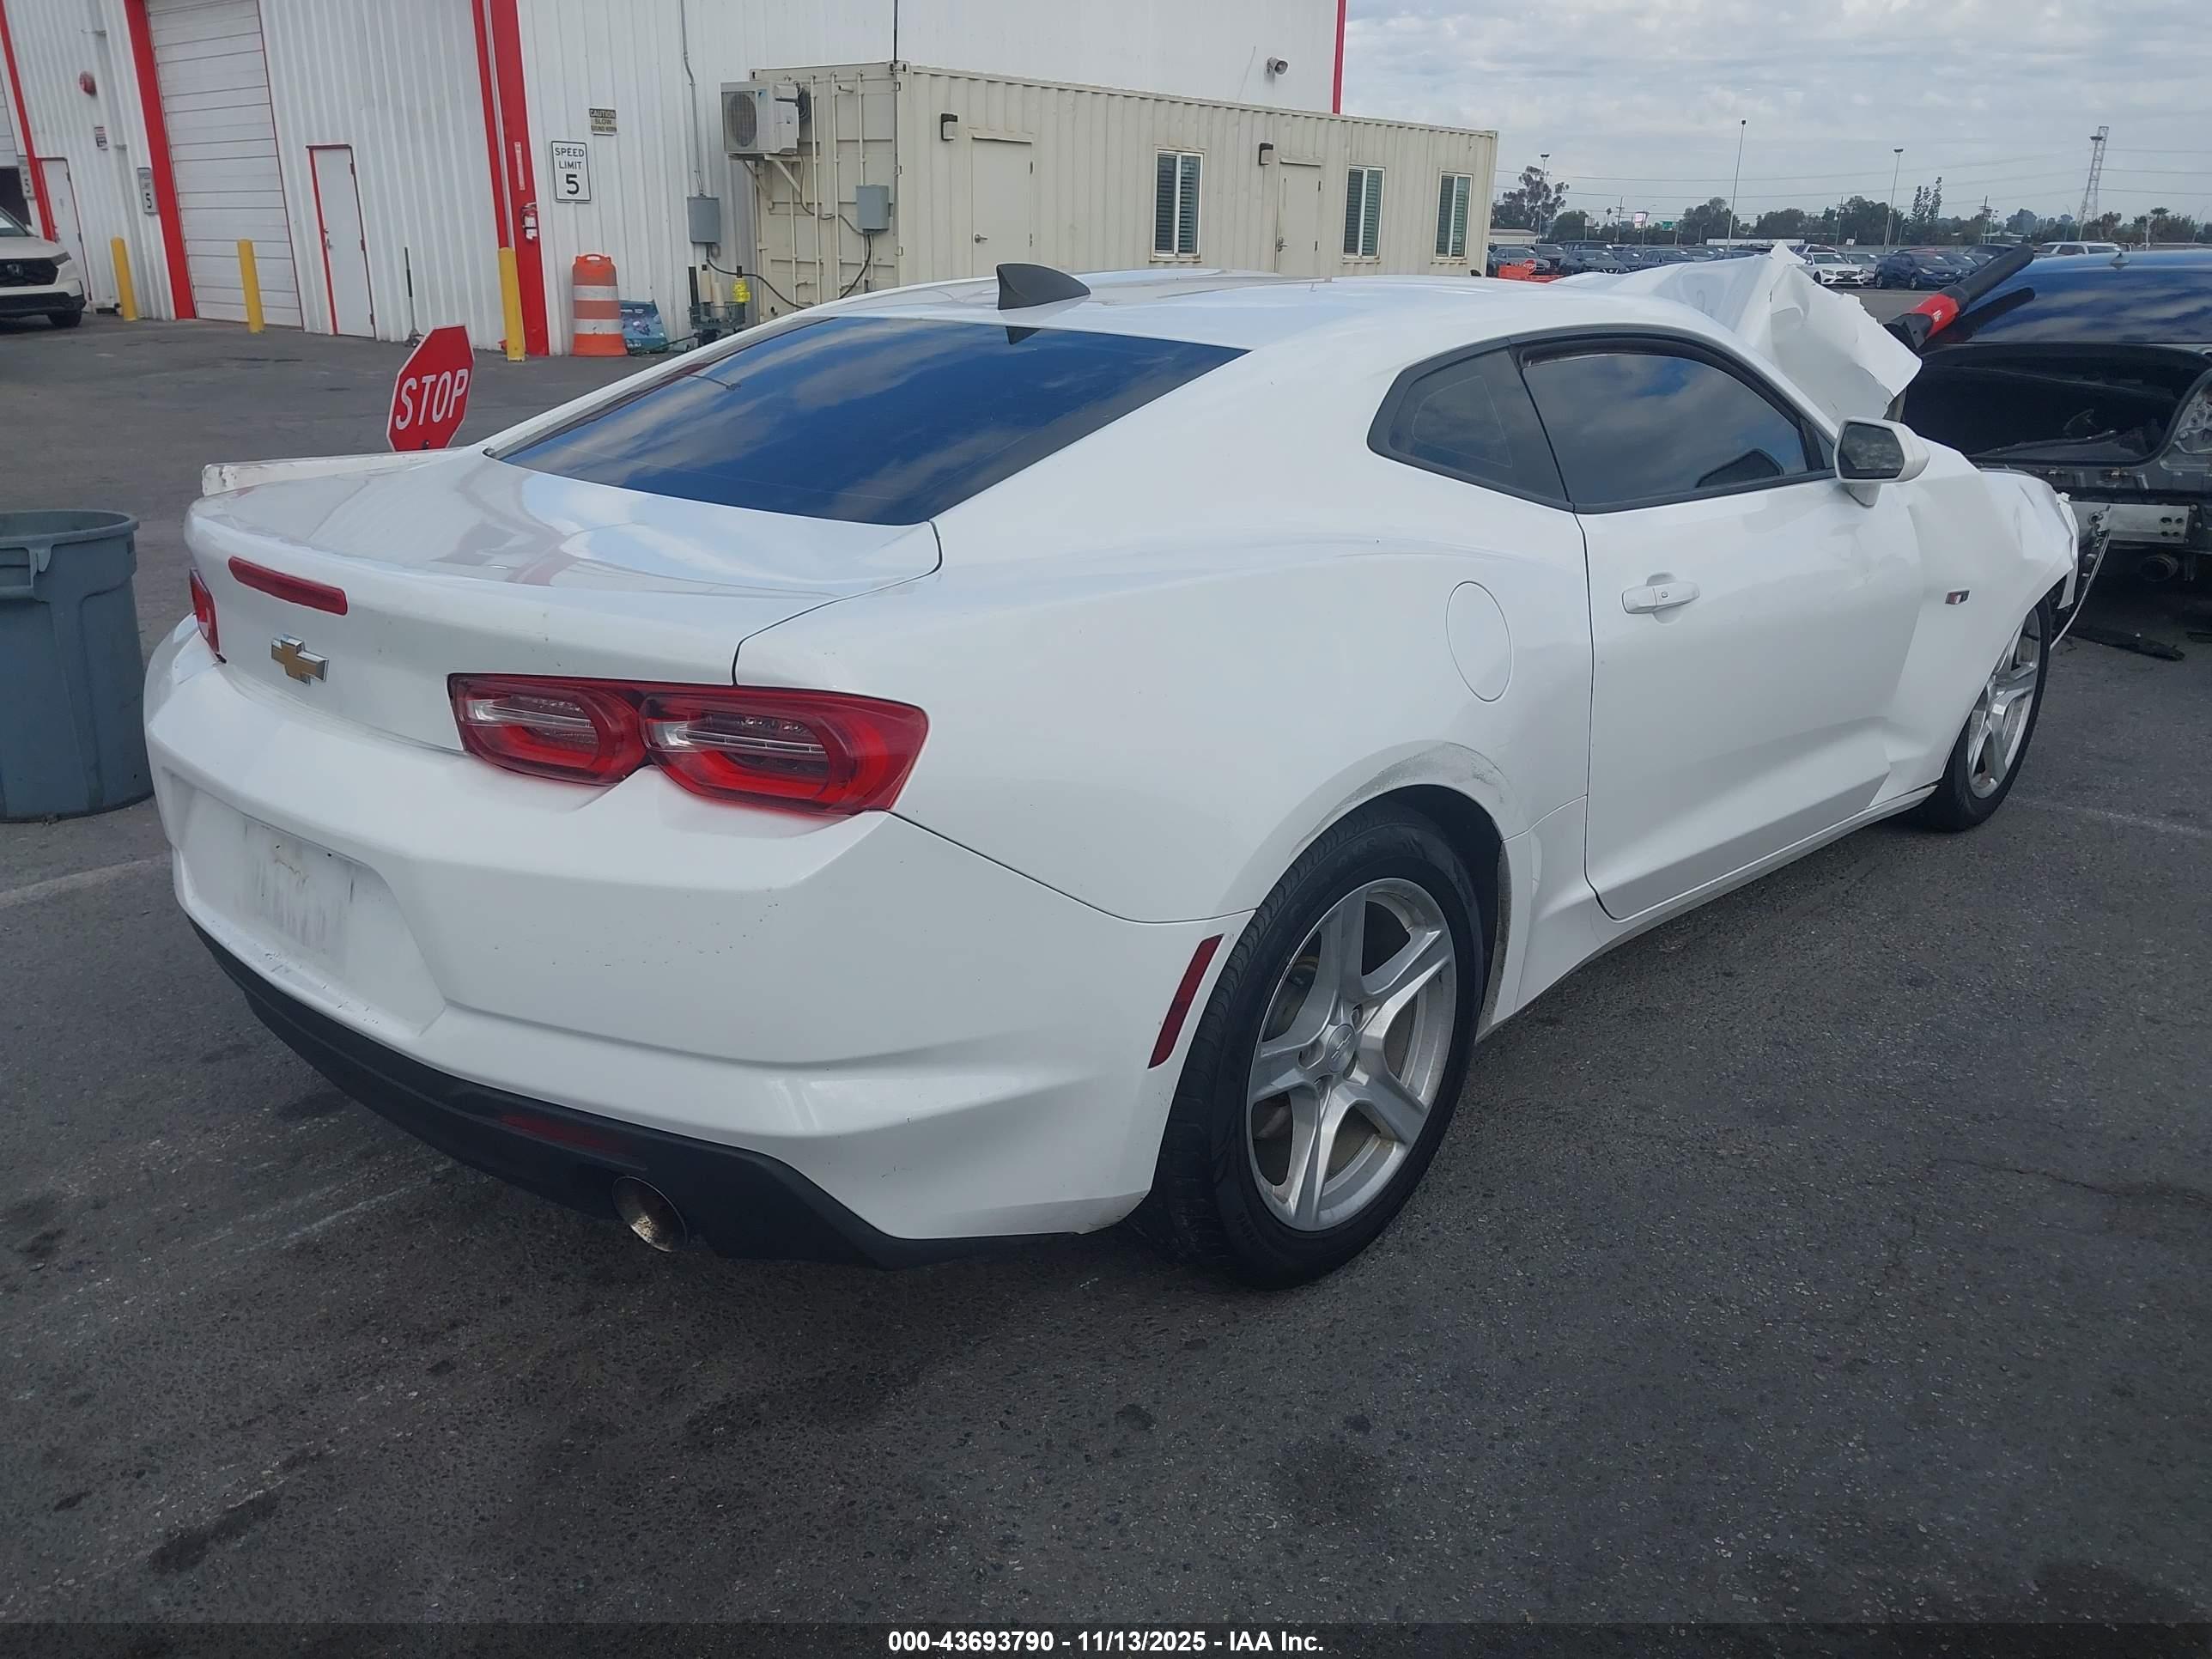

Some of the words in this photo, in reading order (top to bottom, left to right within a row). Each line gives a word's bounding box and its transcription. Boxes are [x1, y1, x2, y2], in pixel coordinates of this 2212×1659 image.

[555, 147, 585, 157] SPEED
[559, 161, 582, 169] LIMIT
[566, 173, 580, 195] 5
[145, 192, 153, 209] 5
[395, 368, 469, 430] STOP
